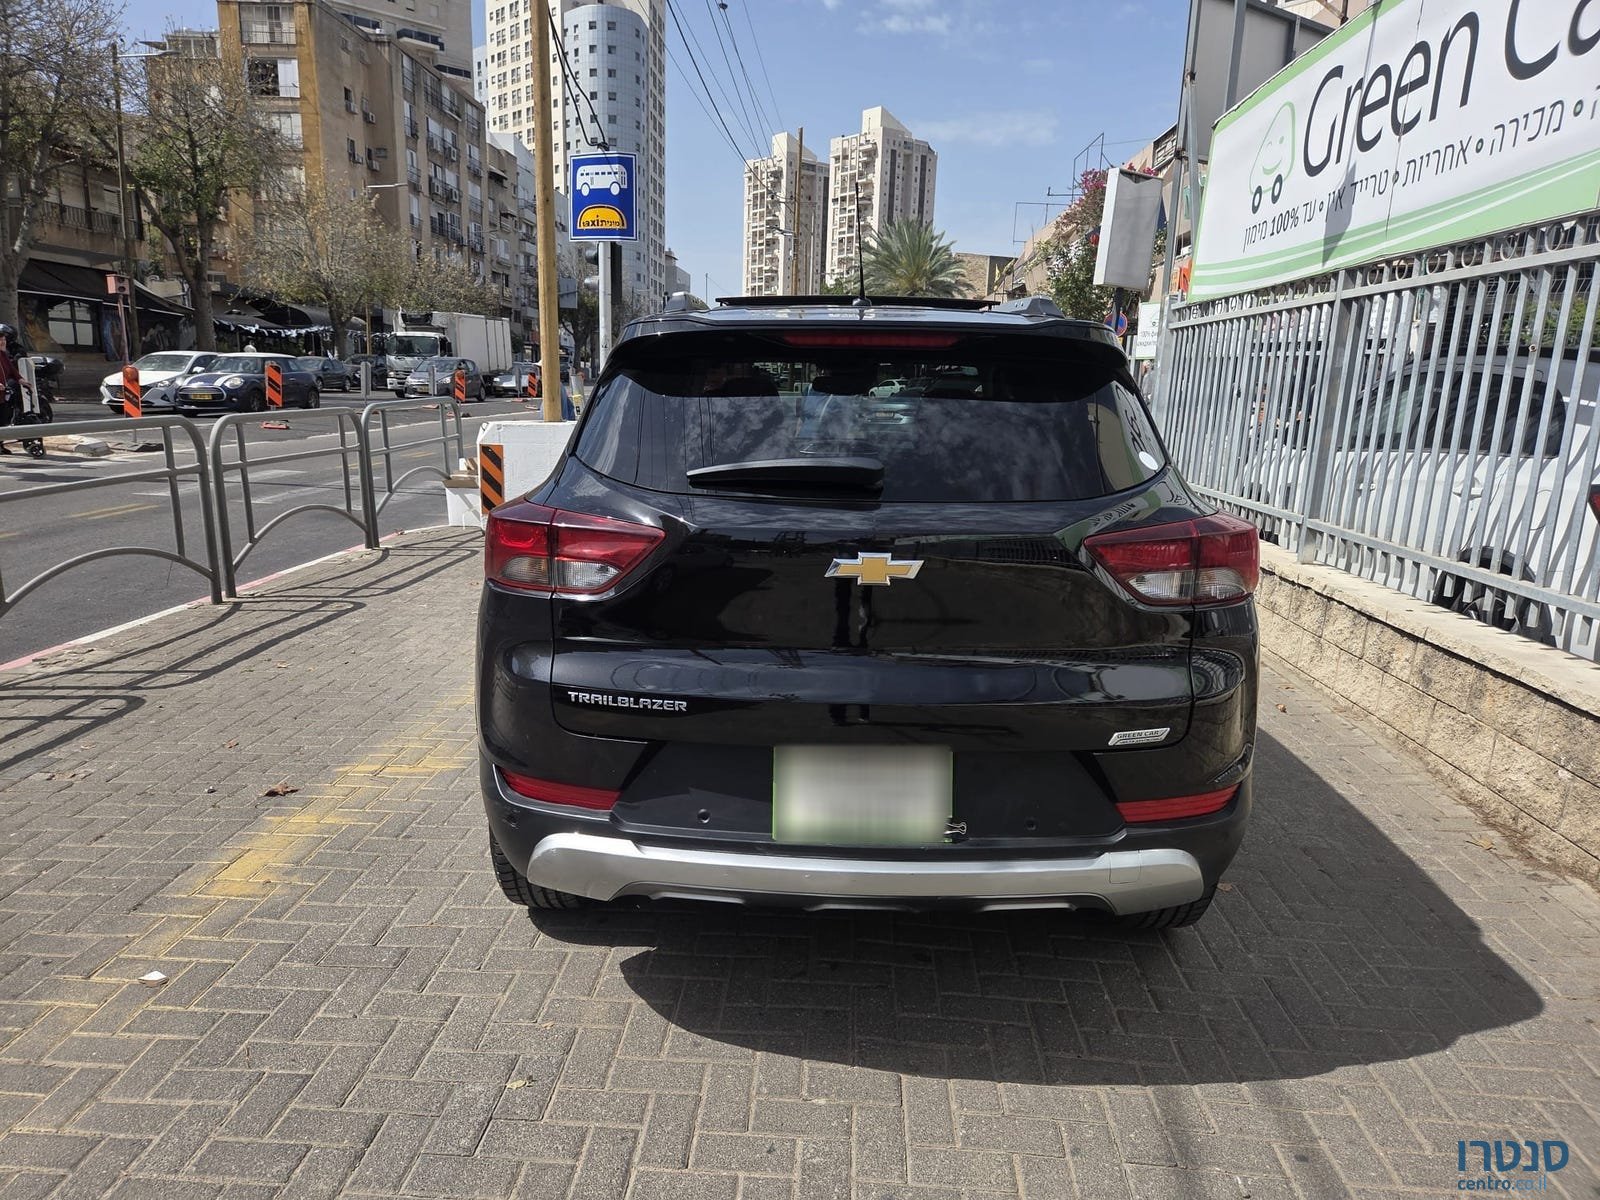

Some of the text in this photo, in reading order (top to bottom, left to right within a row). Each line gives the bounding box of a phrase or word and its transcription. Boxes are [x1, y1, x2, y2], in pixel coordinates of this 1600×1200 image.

[1303, 11, 1480, 178] Green
[1489, 99, 1565, 156] מכירה
[1402, 135, 1473, 187] אחריות
[1350, 169, 1389, 206] טרייד
[582, 214, 600, 227] taxi
[1269, 205, 1299, 237] 100%
[1302, 199, 1317, 224] עד
[1325, 186, 1347, 223] אין
[1243, 220, 1268, 253] מימון
[567, 691, 688, 712] TRAILBLAZER
[1117, 731, 1142, 739] GREEN
